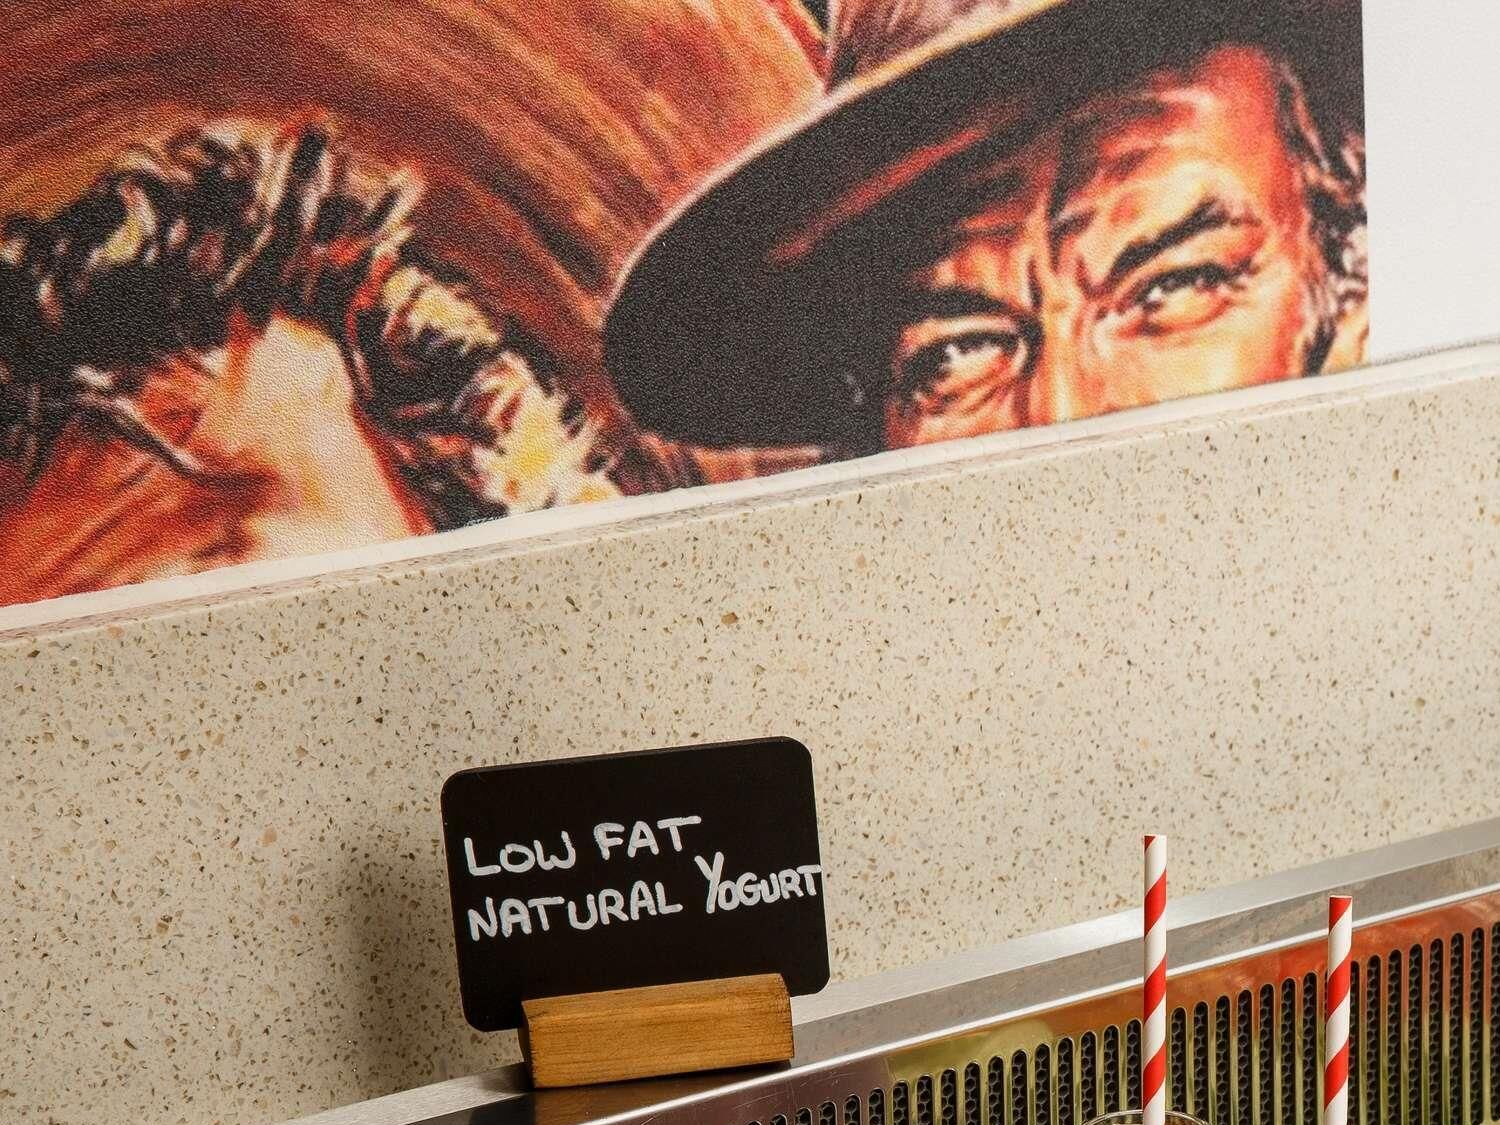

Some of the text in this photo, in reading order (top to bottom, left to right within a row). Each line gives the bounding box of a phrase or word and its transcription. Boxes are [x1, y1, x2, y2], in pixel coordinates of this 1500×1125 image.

[464, 815, 702, 876] LOW FAT
[467, 852, 823, 941] NATURAL YOGURT
